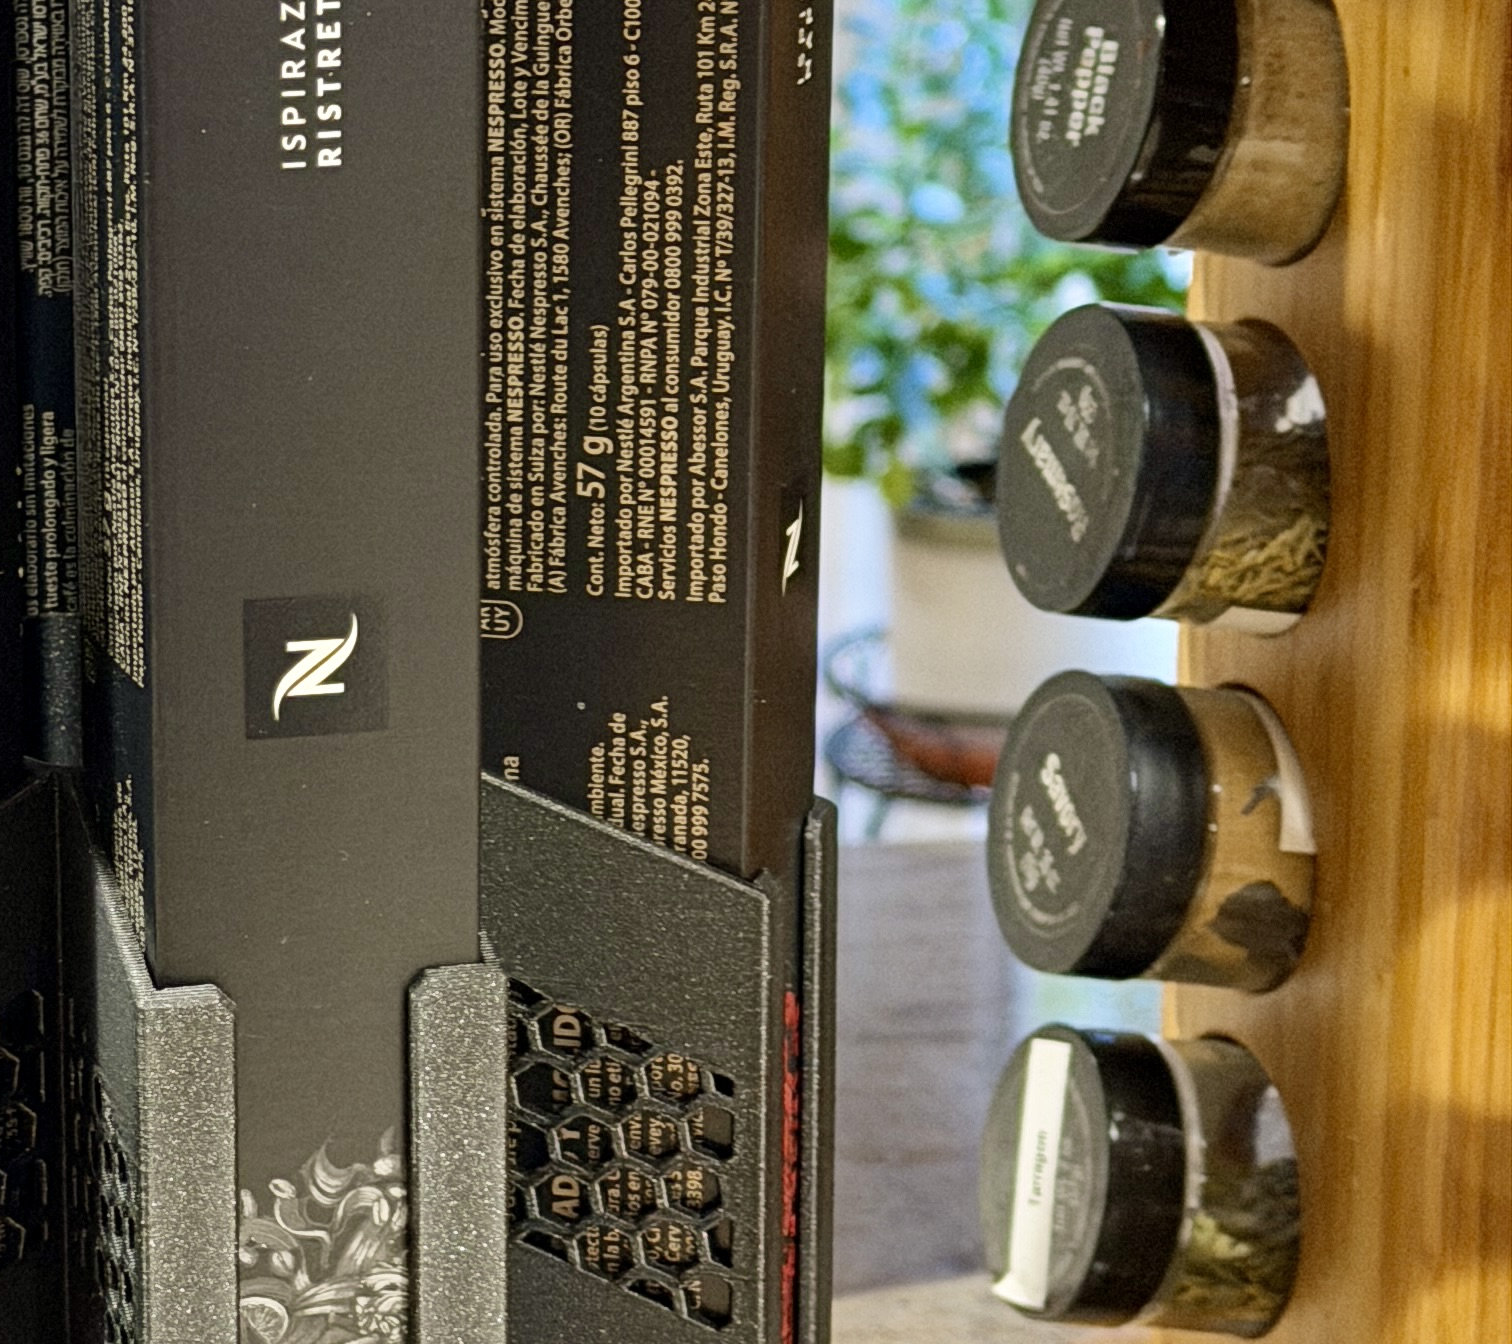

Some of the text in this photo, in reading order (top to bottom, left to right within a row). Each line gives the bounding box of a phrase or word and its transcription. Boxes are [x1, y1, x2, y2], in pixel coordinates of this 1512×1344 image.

[697, 17, 716, 44] Km
[623, 55, 640, 65] 6
[697, 51, 714, 78] 101
[622, 69, 643, 105] piso
[696, 84, 713, 123] Ruta
[718, 74, 741, 111] Reg.
[1065, 26, 1105, 147] Pepper
[1084, 40, 1119, 136] Black
[622, 109, 639, 141] 887
[695, 128, 714, 168] Este,
[717, 116, 735, 148] I.M.
[620, 146, 642, 227] Pellegrini
[694, 173, 712, 216] Zona
[715, 153, 736, 257] T/39/327-13,
[619, 232, 637, 284] Carlos
[641, 180, 660, 309] 079-00-021094
[691, 221, 711, 302] Industrial
[619, 299, 636, 326] S.A
[691, 307, 712, 366] Parque
[617, 331, 638, 415] Argentina
[639, 337, 658, 383] RNPA
[658, 160, 683, 600] Servicios NESPRESSO al consumidor 0800 999 0392.
[712, 316, 735, 392] Uruguay.
[689, 371, 708, 403] S.A.
[576, 325, 613, 596] Cont. Neto: 57 g (10 cápsulas)
[616, 419, 634, 471] Nestlé
[638, 400, 657, 478] 00014591
[688, 407, 707, 476] Abessor
[711, 397, 732, 490] Canelones,
[39, 412, 59, 608] tueste prolongado y ligera
[620, 475, 637, 504] por
[692, 479, 709, 508] por
[637, 505, 655, 538] RNE
[709, 503, 727, 560] Hondo
[614, 509, 635, 597] Importado
[636, 553, 654, 598] CABA
[686, 512, 708, 601] Importado
[708, 564, 726, 602] Paso
